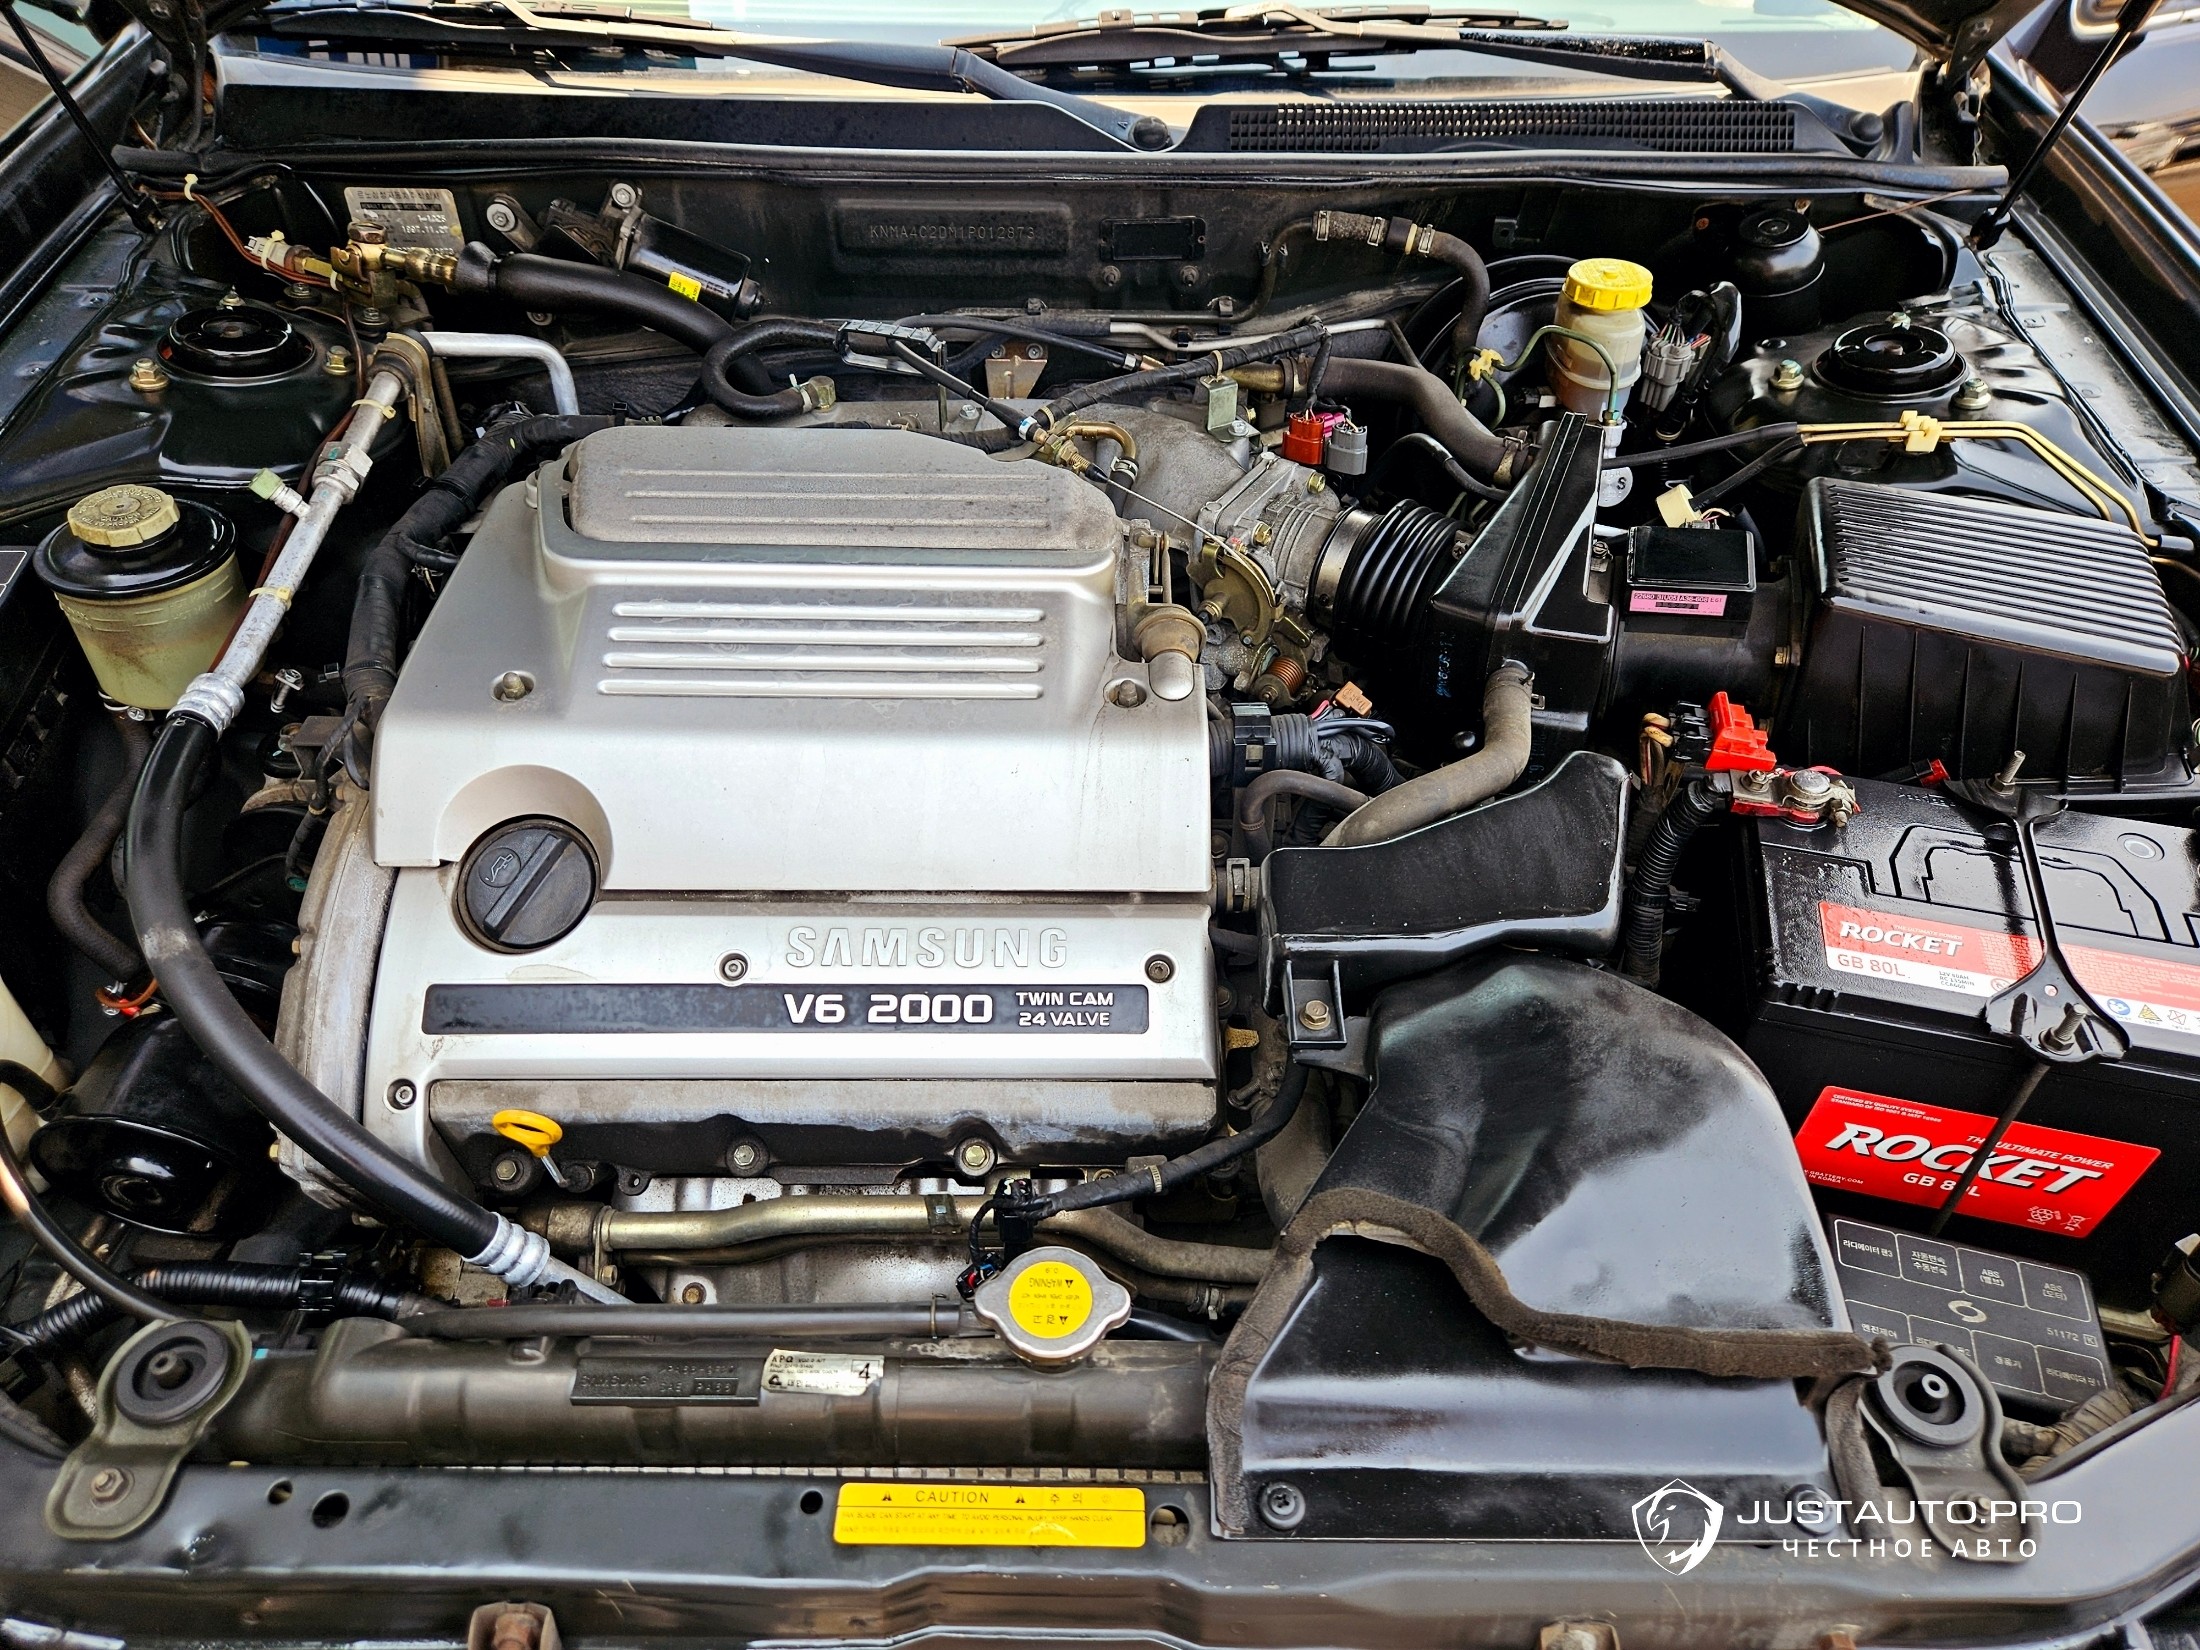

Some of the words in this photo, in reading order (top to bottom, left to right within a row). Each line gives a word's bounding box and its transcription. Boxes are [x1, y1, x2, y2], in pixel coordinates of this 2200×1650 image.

[1616, 476, 1627, 490] S
[785, 926, 1067, 968] SAMSUNG
[1840, 920, 1962, 957] ROCKET
[1837, 953, 1864, 969] GB
[1870, 959, 1905, 977] 80L
[784, 993, 845, 1024] V6
[867, 993, 993, 1024] 2000
[1016, 992, 1066, 1006] TWIN
[1069, 992, 1114, 1006] CAM
[1019, 1013, 1046, 1026] 24
[1049, 1012, 1110, 1026] VALVE
[1824, 1121, 2104, 1193] ROCKET
[1966, 1135, 1986, 1144] TH
[1995, 1141, 2062, 1159] ULTIMATE
[2060, 1154, 2114, 1170] POWER
[1903, 1172, 1937, 1187] GB
[1940, 1179, 1981, 1197] 8L
[1981, 1268, 2000, 1279] ABS
[2044, 1282, 2063, 1293] ABS
[2046, 1327, 2079, 1342] 51172
[914, 1490, 989, 1504] CAUTION
